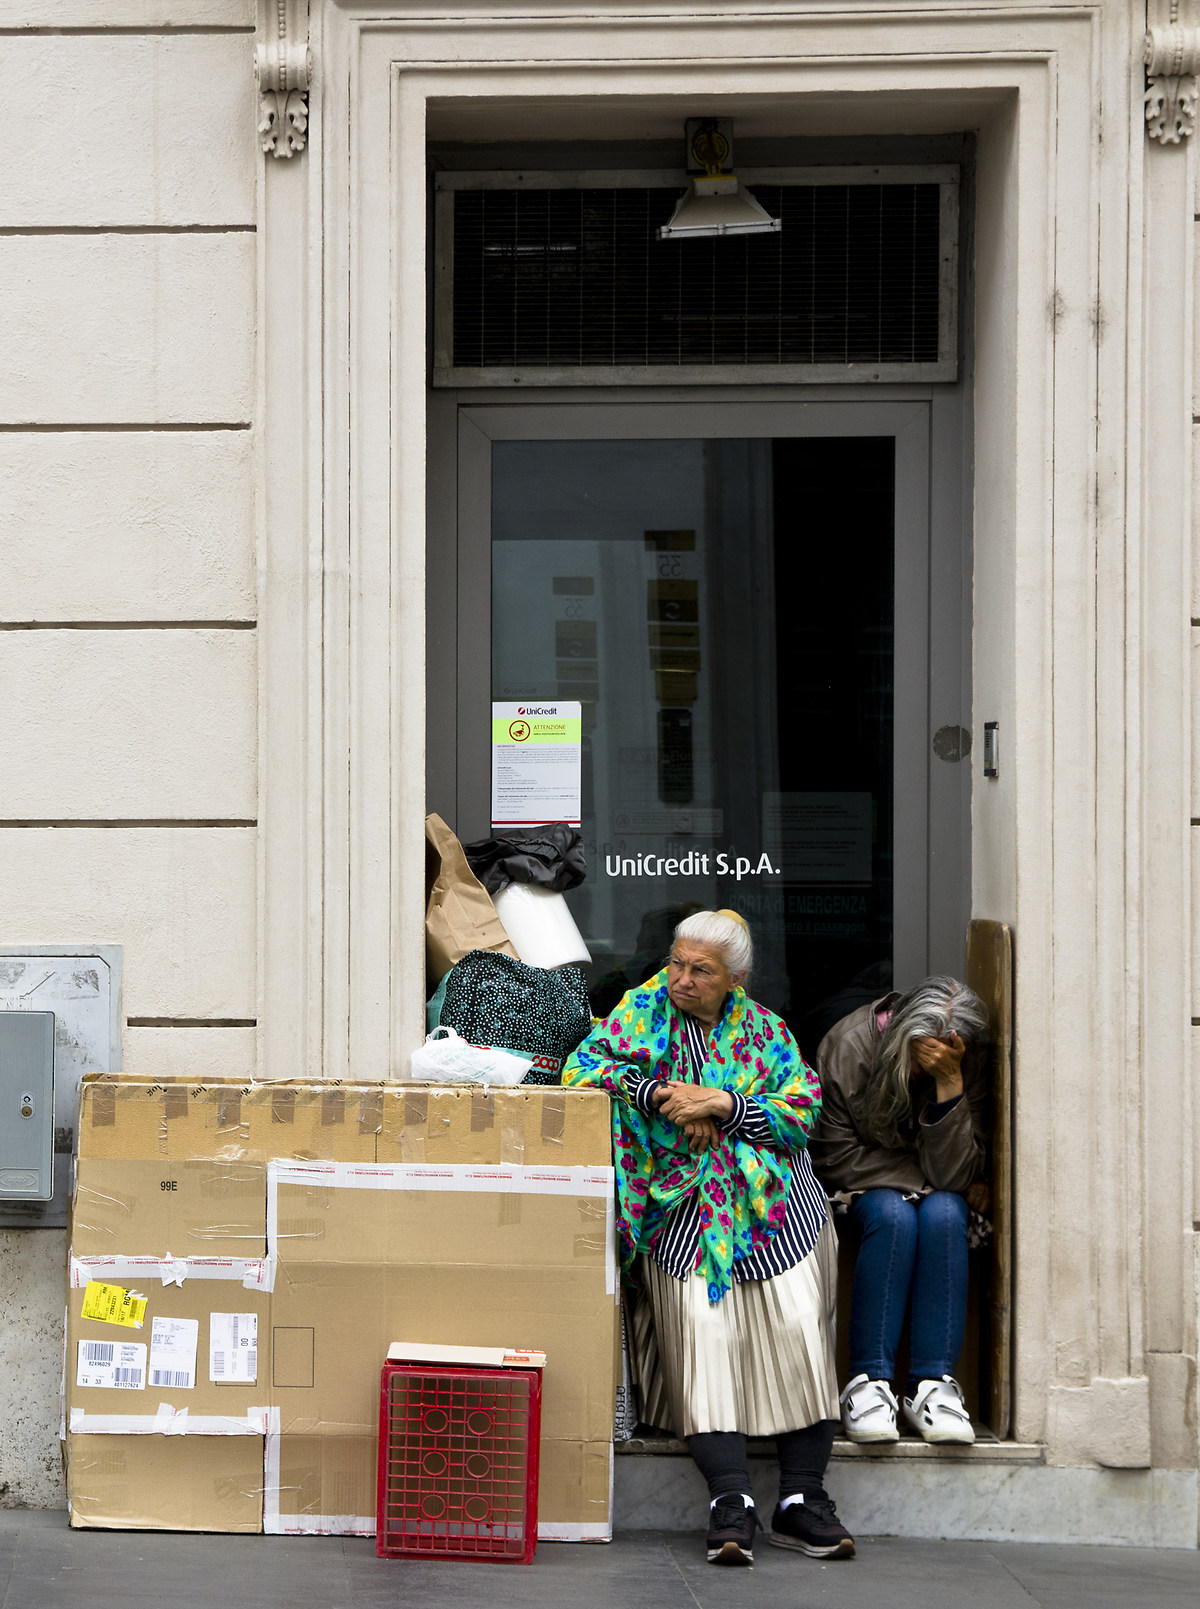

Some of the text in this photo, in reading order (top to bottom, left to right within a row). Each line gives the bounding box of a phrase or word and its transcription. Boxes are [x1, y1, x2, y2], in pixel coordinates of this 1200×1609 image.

[526, 707, 557, 715] UniCredit
[605, 851, 781, 881] UniCredit S.p.A.
[787, 896, 867, 914] EMERGENZA
[532, 1055, 559, 1073] coop
[160, 1181, 178, 1192] 99E
